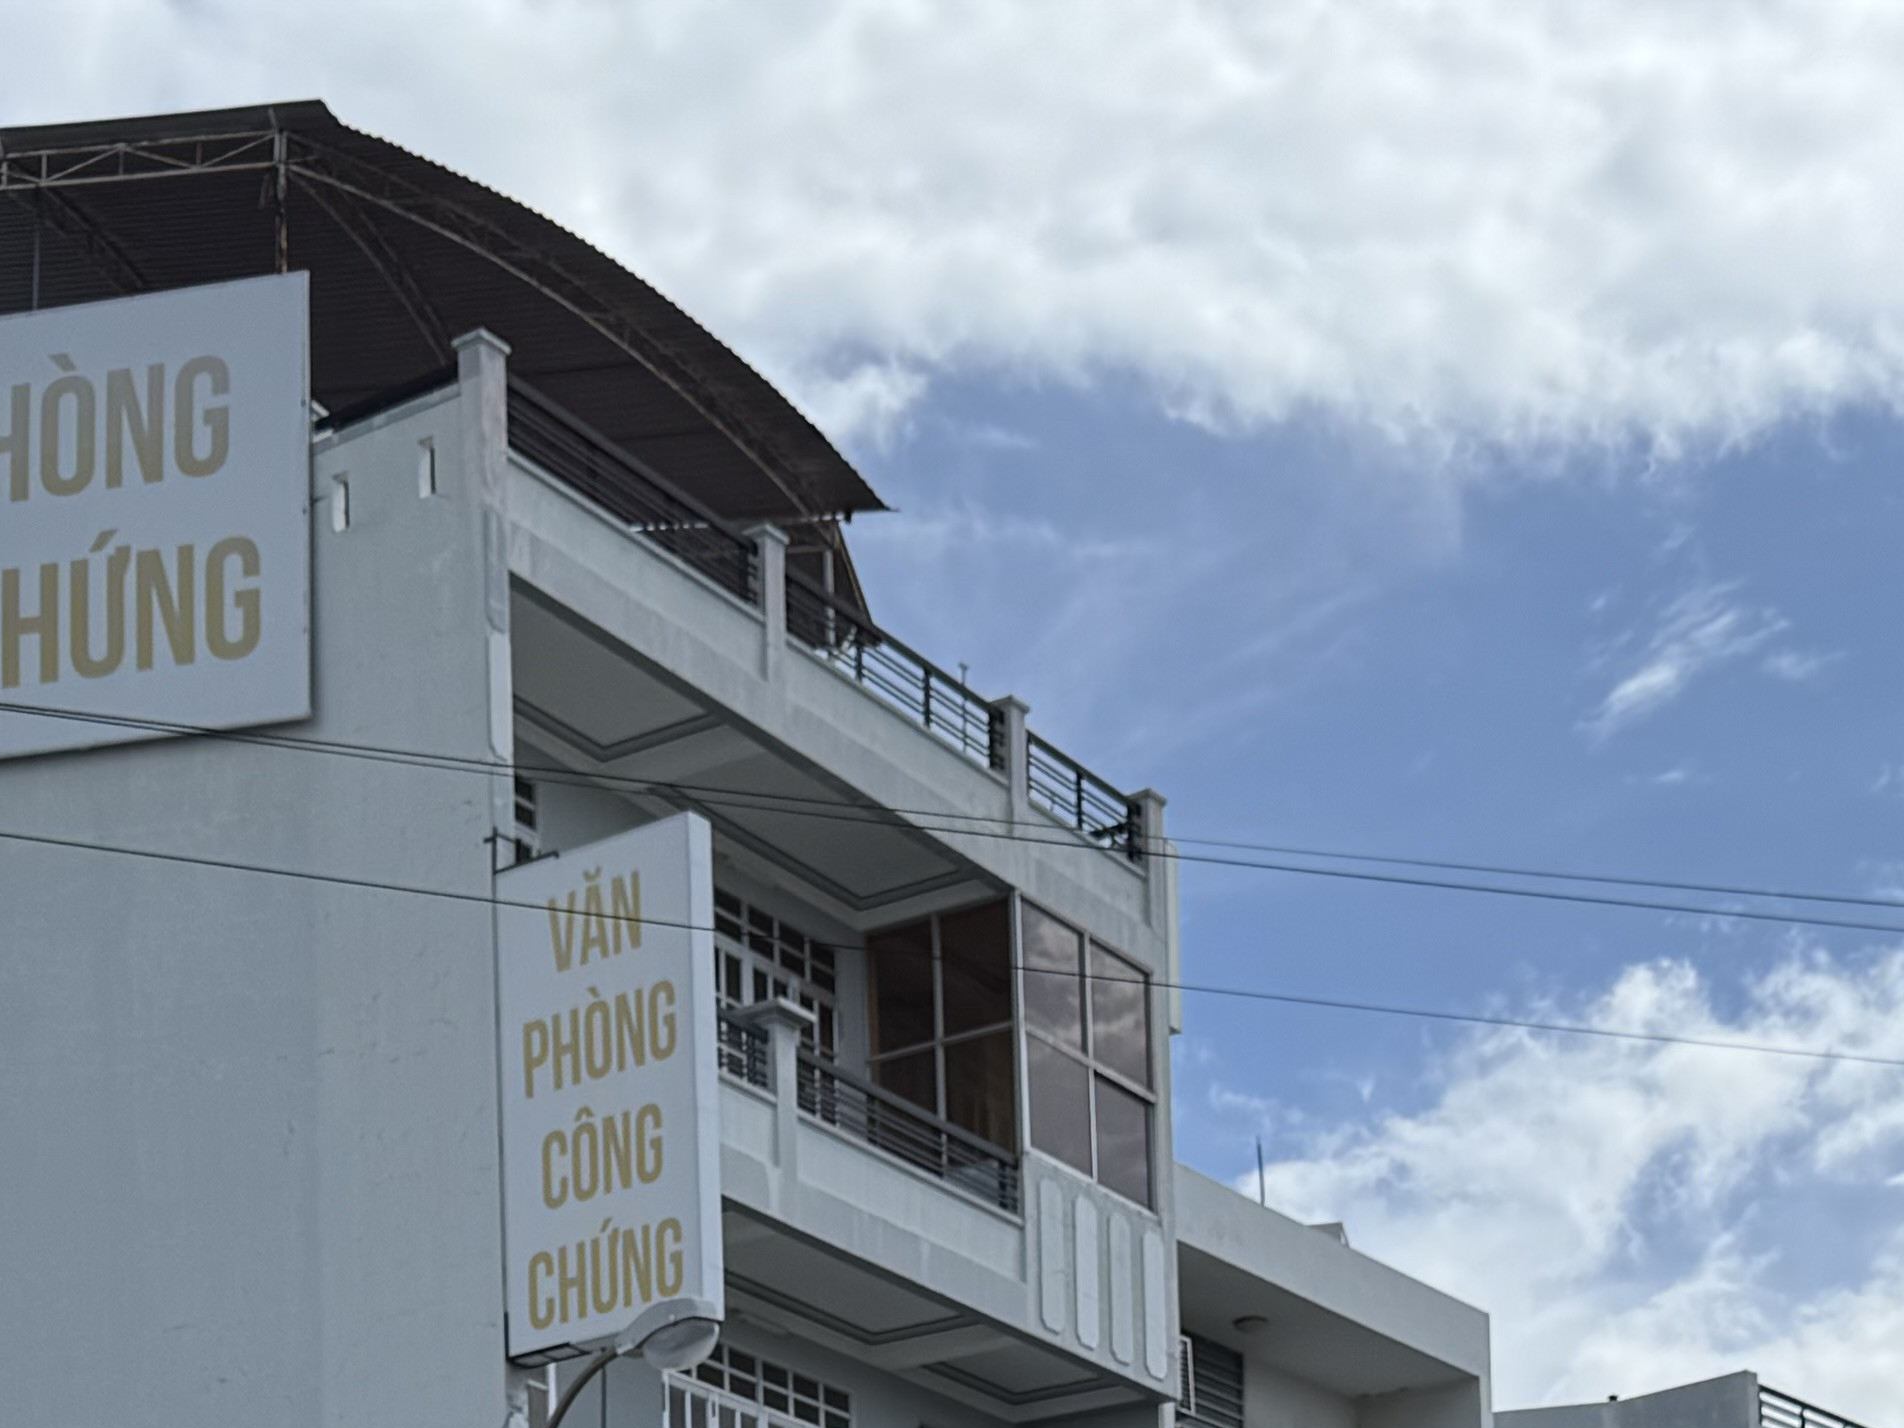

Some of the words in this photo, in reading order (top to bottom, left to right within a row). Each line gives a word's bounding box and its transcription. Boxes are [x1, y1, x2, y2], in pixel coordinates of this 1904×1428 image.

[547, 866, 644, 975] VĂN
[521, 979, 679, 1100] PHÒNG
[540, 1102, 665, 1211] CÔNG
[527, 1216, 686, 1332] CHỨNG
